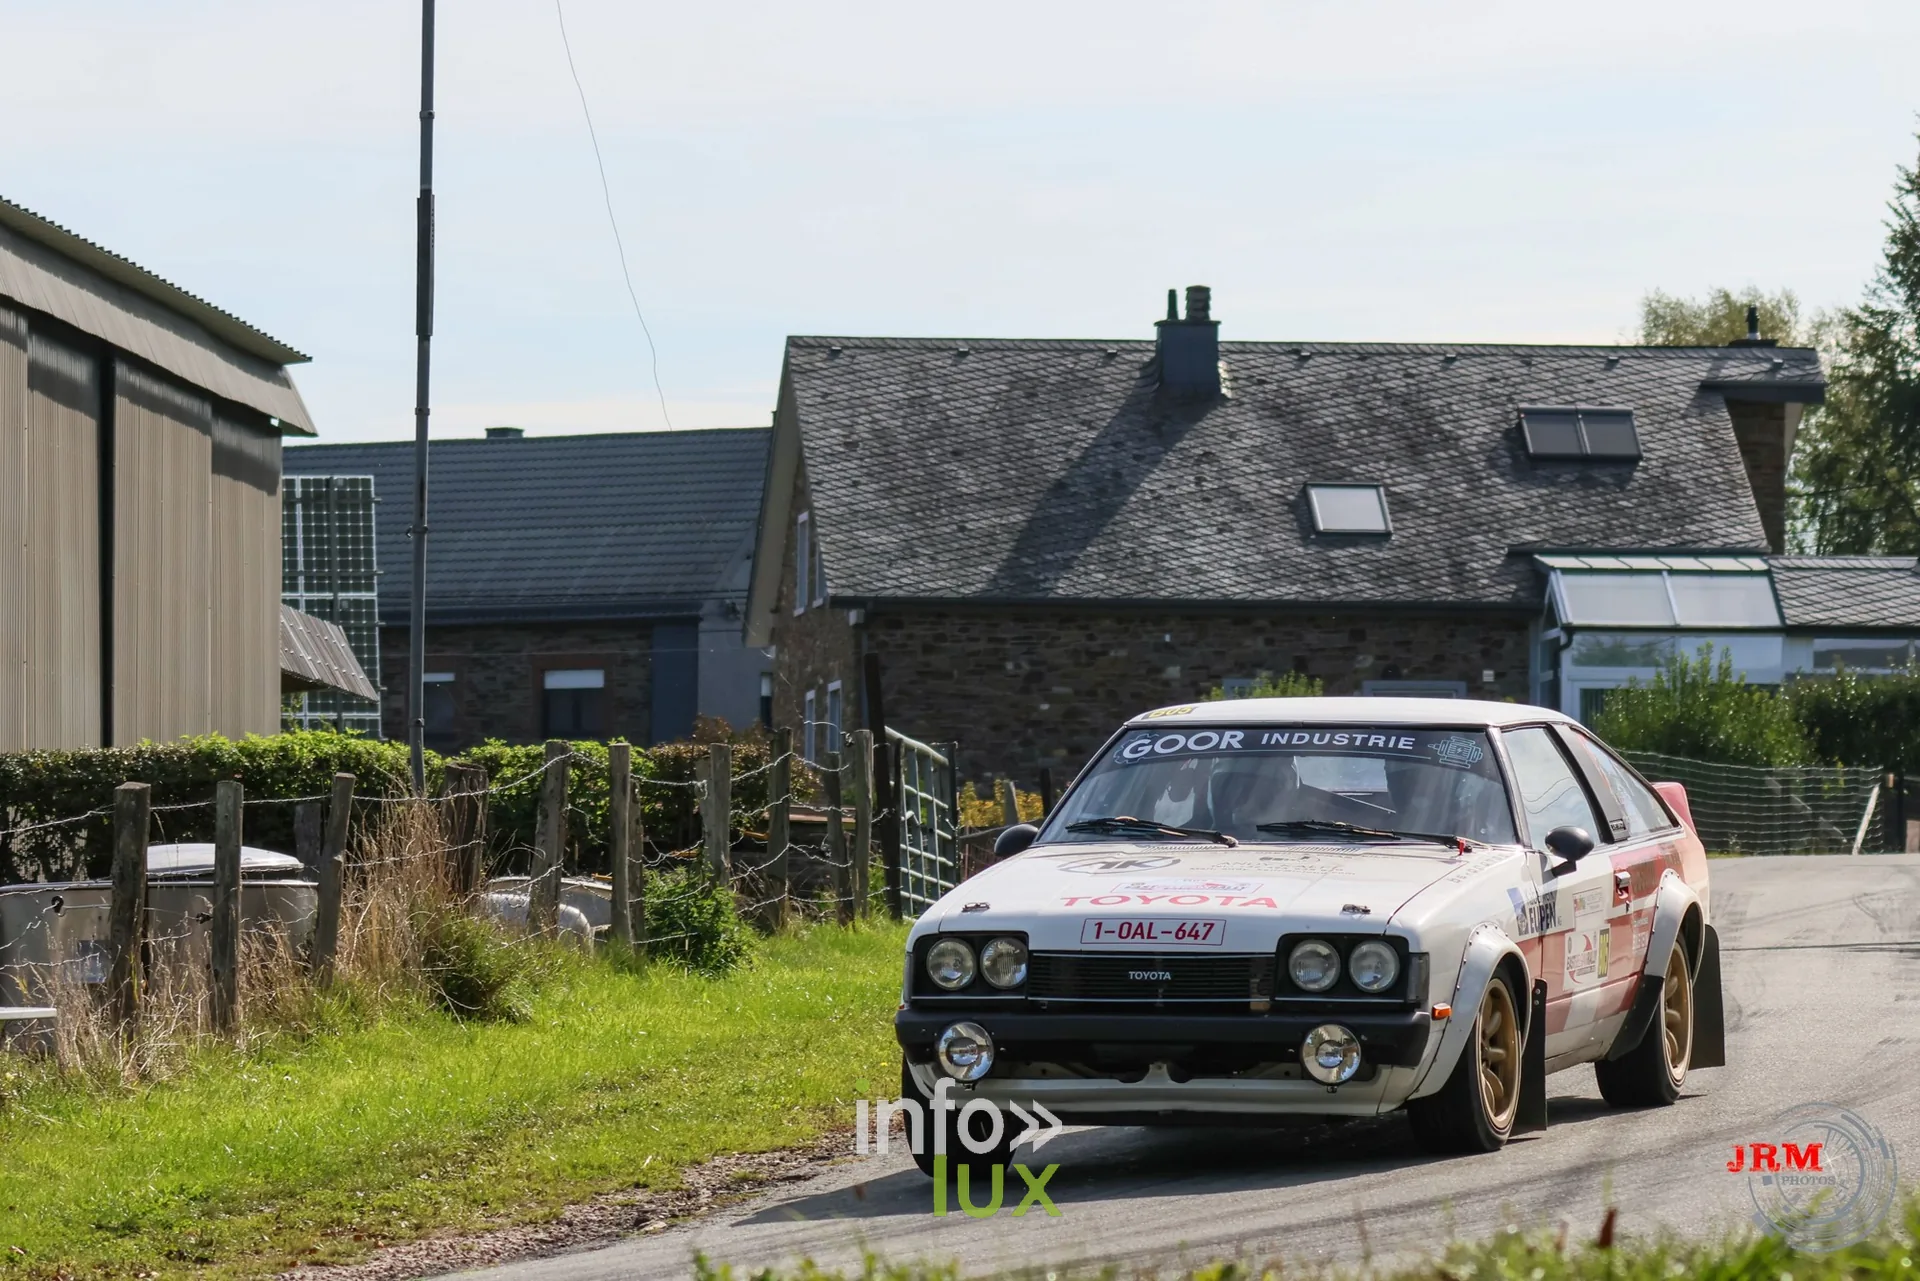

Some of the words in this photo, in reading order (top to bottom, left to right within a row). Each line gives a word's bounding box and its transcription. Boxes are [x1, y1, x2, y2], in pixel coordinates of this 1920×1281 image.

[1122, 731, 1244, 760] GOOR
[1261, 732, 1415, 750] INDUSTRIE
[1060, 895, 1278, 909] TOYOTA
[1529, 902, 1557, 934] EUPEN
[1094, 921, 1215, 942] 1-OAL-647
[1129, 971, 1171, 981] TOYOTA
